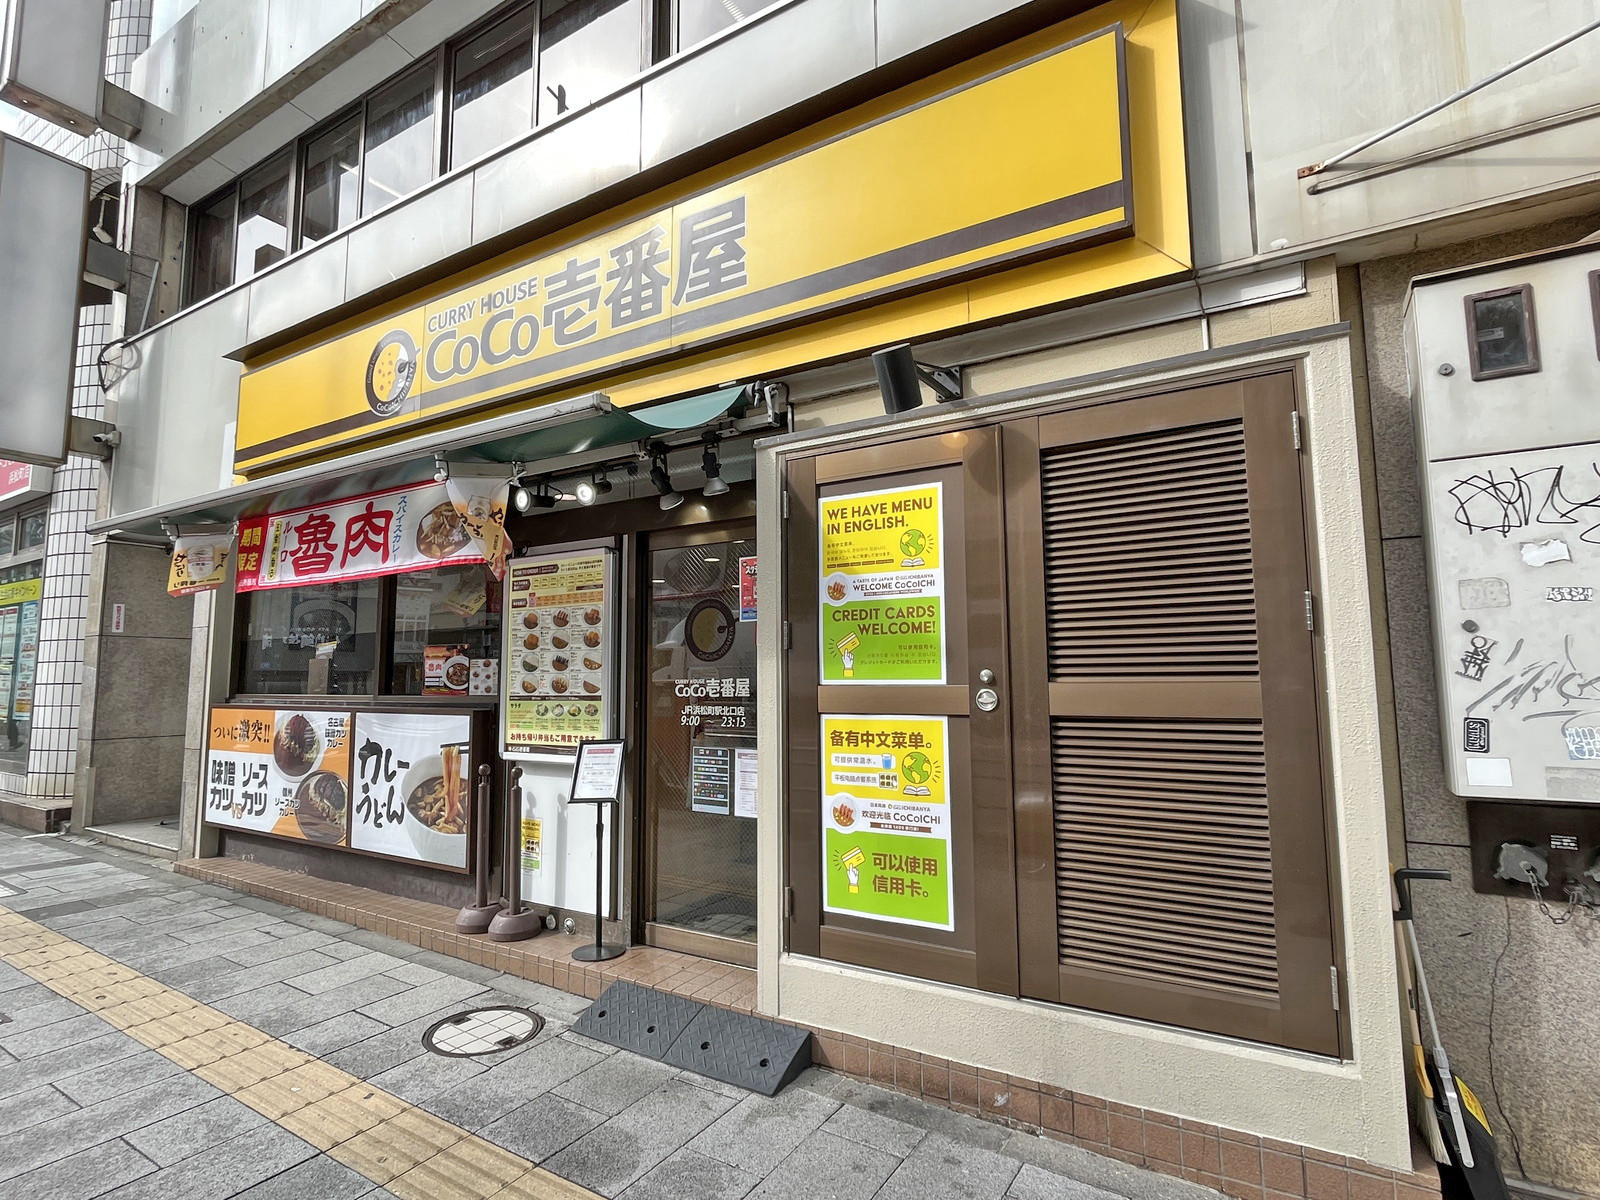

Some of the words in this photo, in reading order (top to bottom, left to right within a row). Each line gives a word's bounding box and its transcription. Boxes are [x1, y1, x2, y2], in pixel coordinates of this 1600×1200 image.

[426, 196, 748, 383] CoCo壱番屋
[427, 300, 476, 333] CURRY
[480, 276, 538, 315] HOUSE
[826, 507, 848, 521] WE
[851, 502, 888, 518] HAVE
[891, 496, 933, 513] MENU
[391, 495, 408, 563] スパイスカレー
[827, 523, 840, 535] IN
[844, 515, 909, 533] ENGLISH.
[289, 501, 395, 578] 魯肉
[853, 582, 893, 591] WELCOME
[894, 579, 935, 589] CoCoICHI
[832, 607, 881, 622] CREDIT
[884, 604, 935, 620] CARDS
[857, 620, 936, 635] WELCOME!
[675, 678, 750, 697] CoCo壱番屋
[681, 705, 745, 716] JR浜松町駅北口店
[681, 715, 700, 726] 9:00
[721, 716, 747, 728] 23:15
[326, 739, 344, 748] カレー
[830, 729, 932, 750] 备有中文菜单。
[358, 737, 410, 785] カレー
[211, 759, 236, 787] 味噌
[242, 762, 269, 790] ソース
[209, 786, 235, 812] カツ
[241, 790, 268, 817] カツ
[278, 807, 295, 817] カレー
[355, 782, 405, 829] うどん
[861, 809, 892, 820] 欢迎光临
[893, 812, 941, 825] CoCoICHI
[871, 852, 938, 877] 可以使用
[872, 874, 929, 898] 信用卡。
